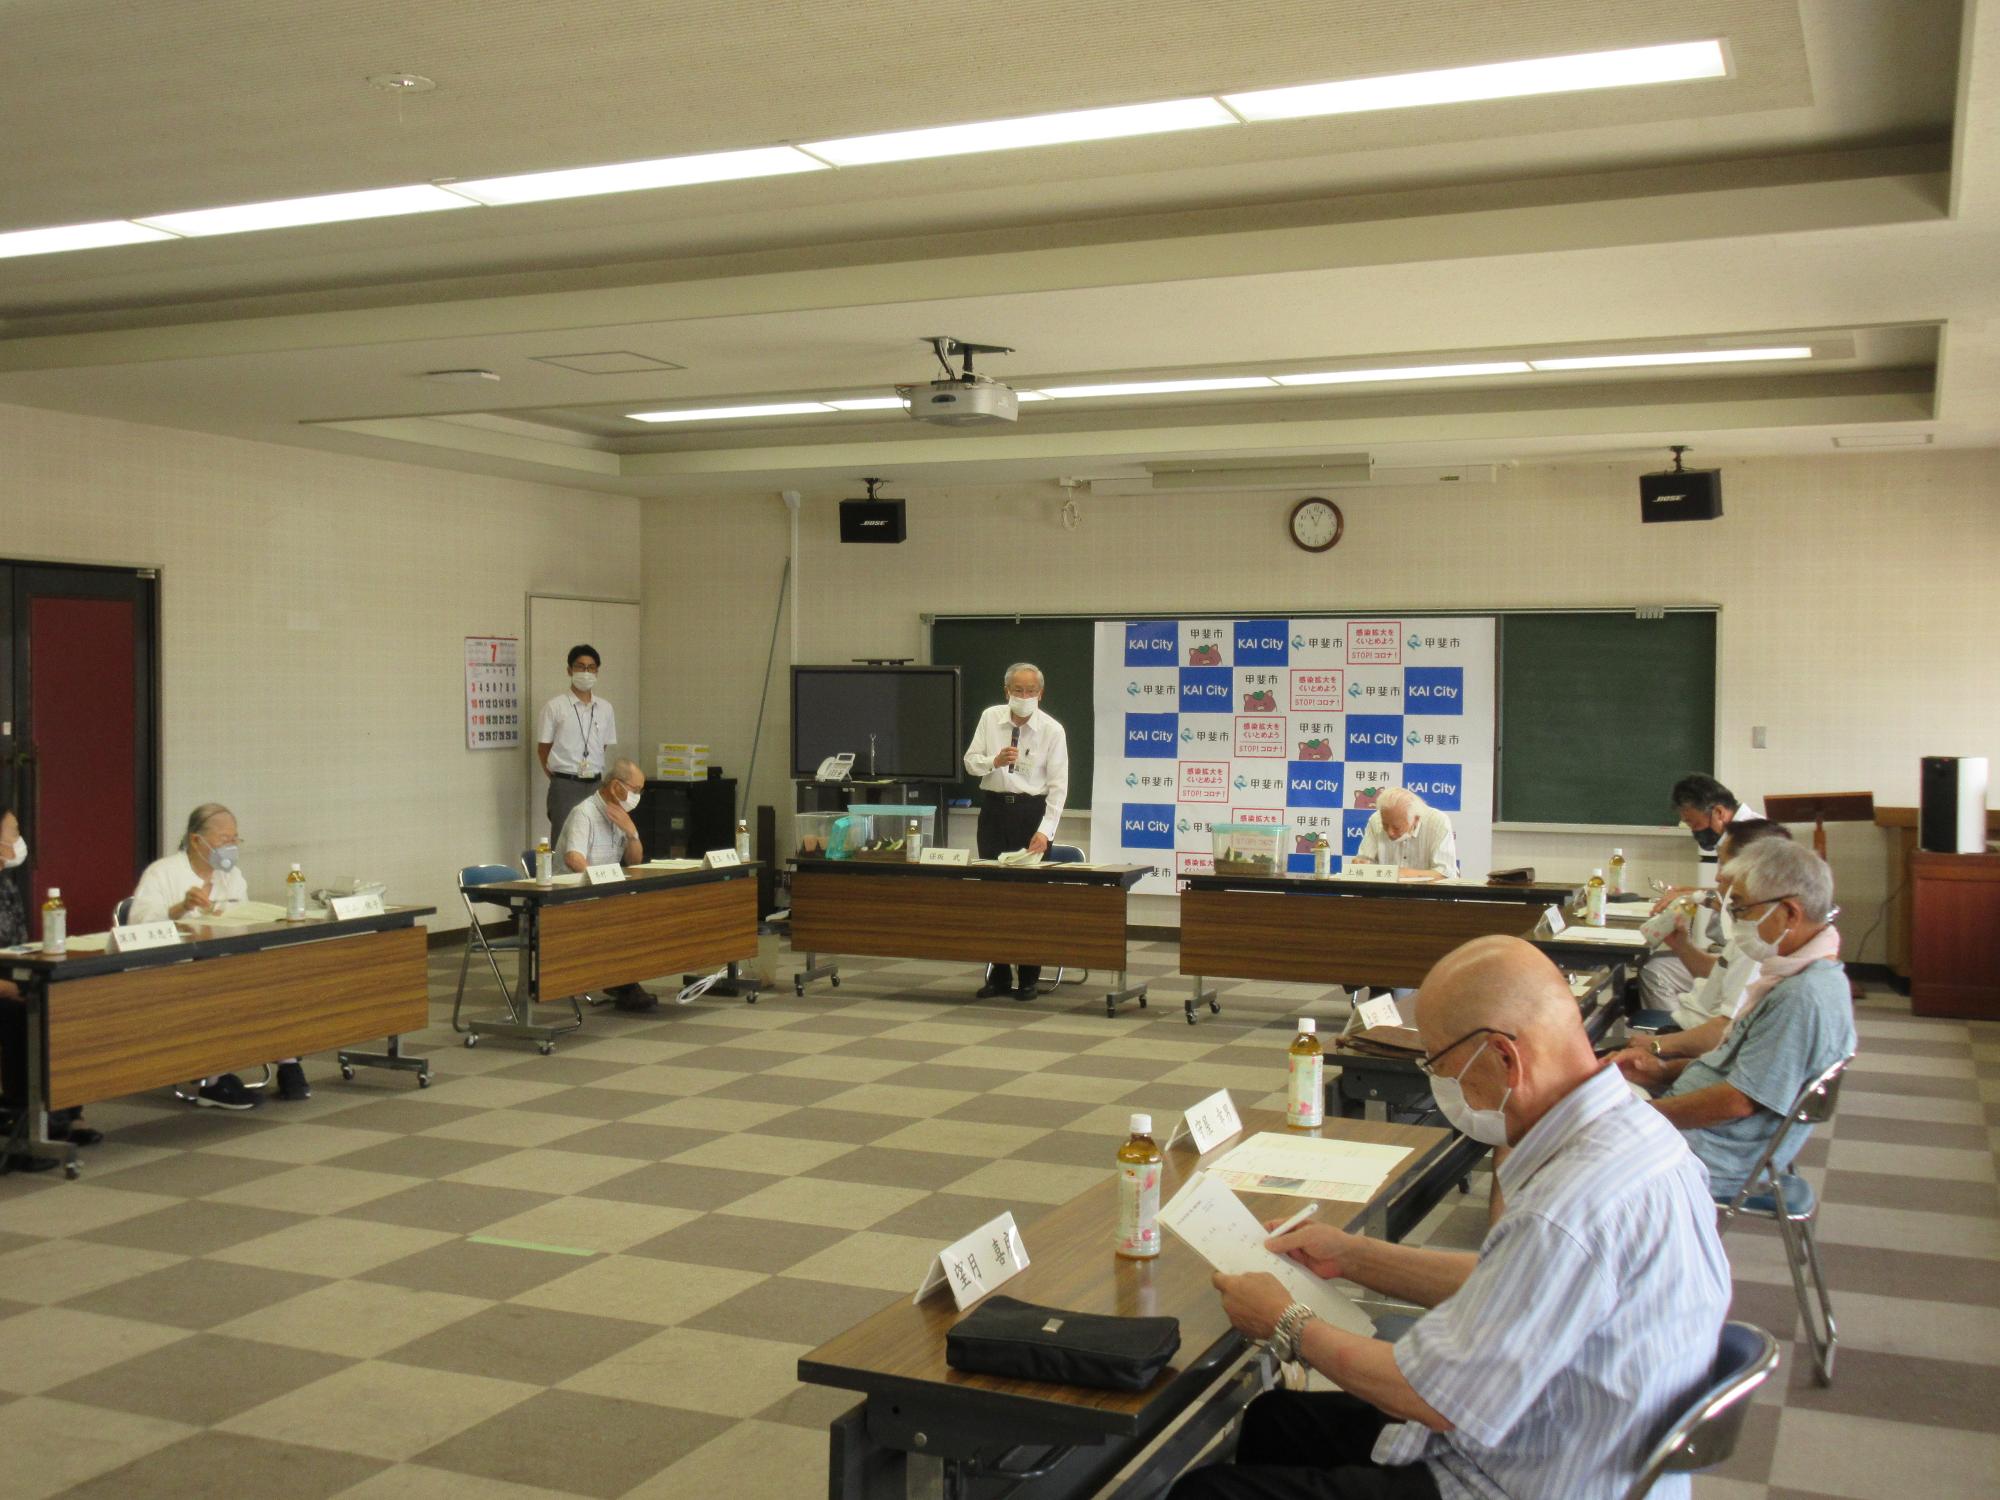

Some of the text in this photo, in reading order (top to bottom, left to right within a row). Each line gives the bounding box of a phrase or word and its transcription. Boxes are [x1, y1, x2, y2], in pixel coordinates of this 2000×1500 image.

[1190, 629, 1223, 639] 甲斐市
[1356, 628, 1394, 637] 感染拡大を
[1129, 638, 1174, 651] KAI City
[1238, 638, 1284, 651] KAI City
[1308, 638, 1343, 649] 甲斐市
[1355, 637, 1394, 645] くいとめよう
[1425, 637, 1460, 649] 甲斐市
[490, 643, 497, 662] 7
[1245, 674, 1279, 685] 甲斐市
[1298, 676, 1337, 684] 感染拡大を
[1143, 685, 1177, 695] 甲斐市
[1183, 684, 1229, 697] KAI City
[1366, 686, 1400, 697] 甲斐市
[1409, 685, 1458, 698] KAI City
[1299, 723, 1334, 734] 甲斐市
[1129, 730, 1174, 743] KAI City
[1196, 731, 1229, 742] 甲斐市
[1243, 731, 1280, 739] くいとめよう
[1350, 733, 1398, 746] KAI City
[1424, 734, 1460, 745] 甲斐市
[1186, 768, 1223, 776] 感染拡大を
[1355, 770, 1390, 782] 甲斐市
[1141, 776, 1174, 787] 甲斐市
[1251, 779, 1284, 790] 甲斐市
[1291, 779, 1339, 792] KAI City
[1407, 782, 1456, 795] KAI City
[1125, 820, 1170, 833] KAI City
[1296, 816, 1331, 827] 甲斐市
[1193, 822, 1212, 833] 甲斐
[1347, 827, 1363, 838] KA
[1184, 859, 1214, 867] 感染拡大
[1150, 867, 1171, 878] 斐市
[954, 1252, 983, 1291] 望月
